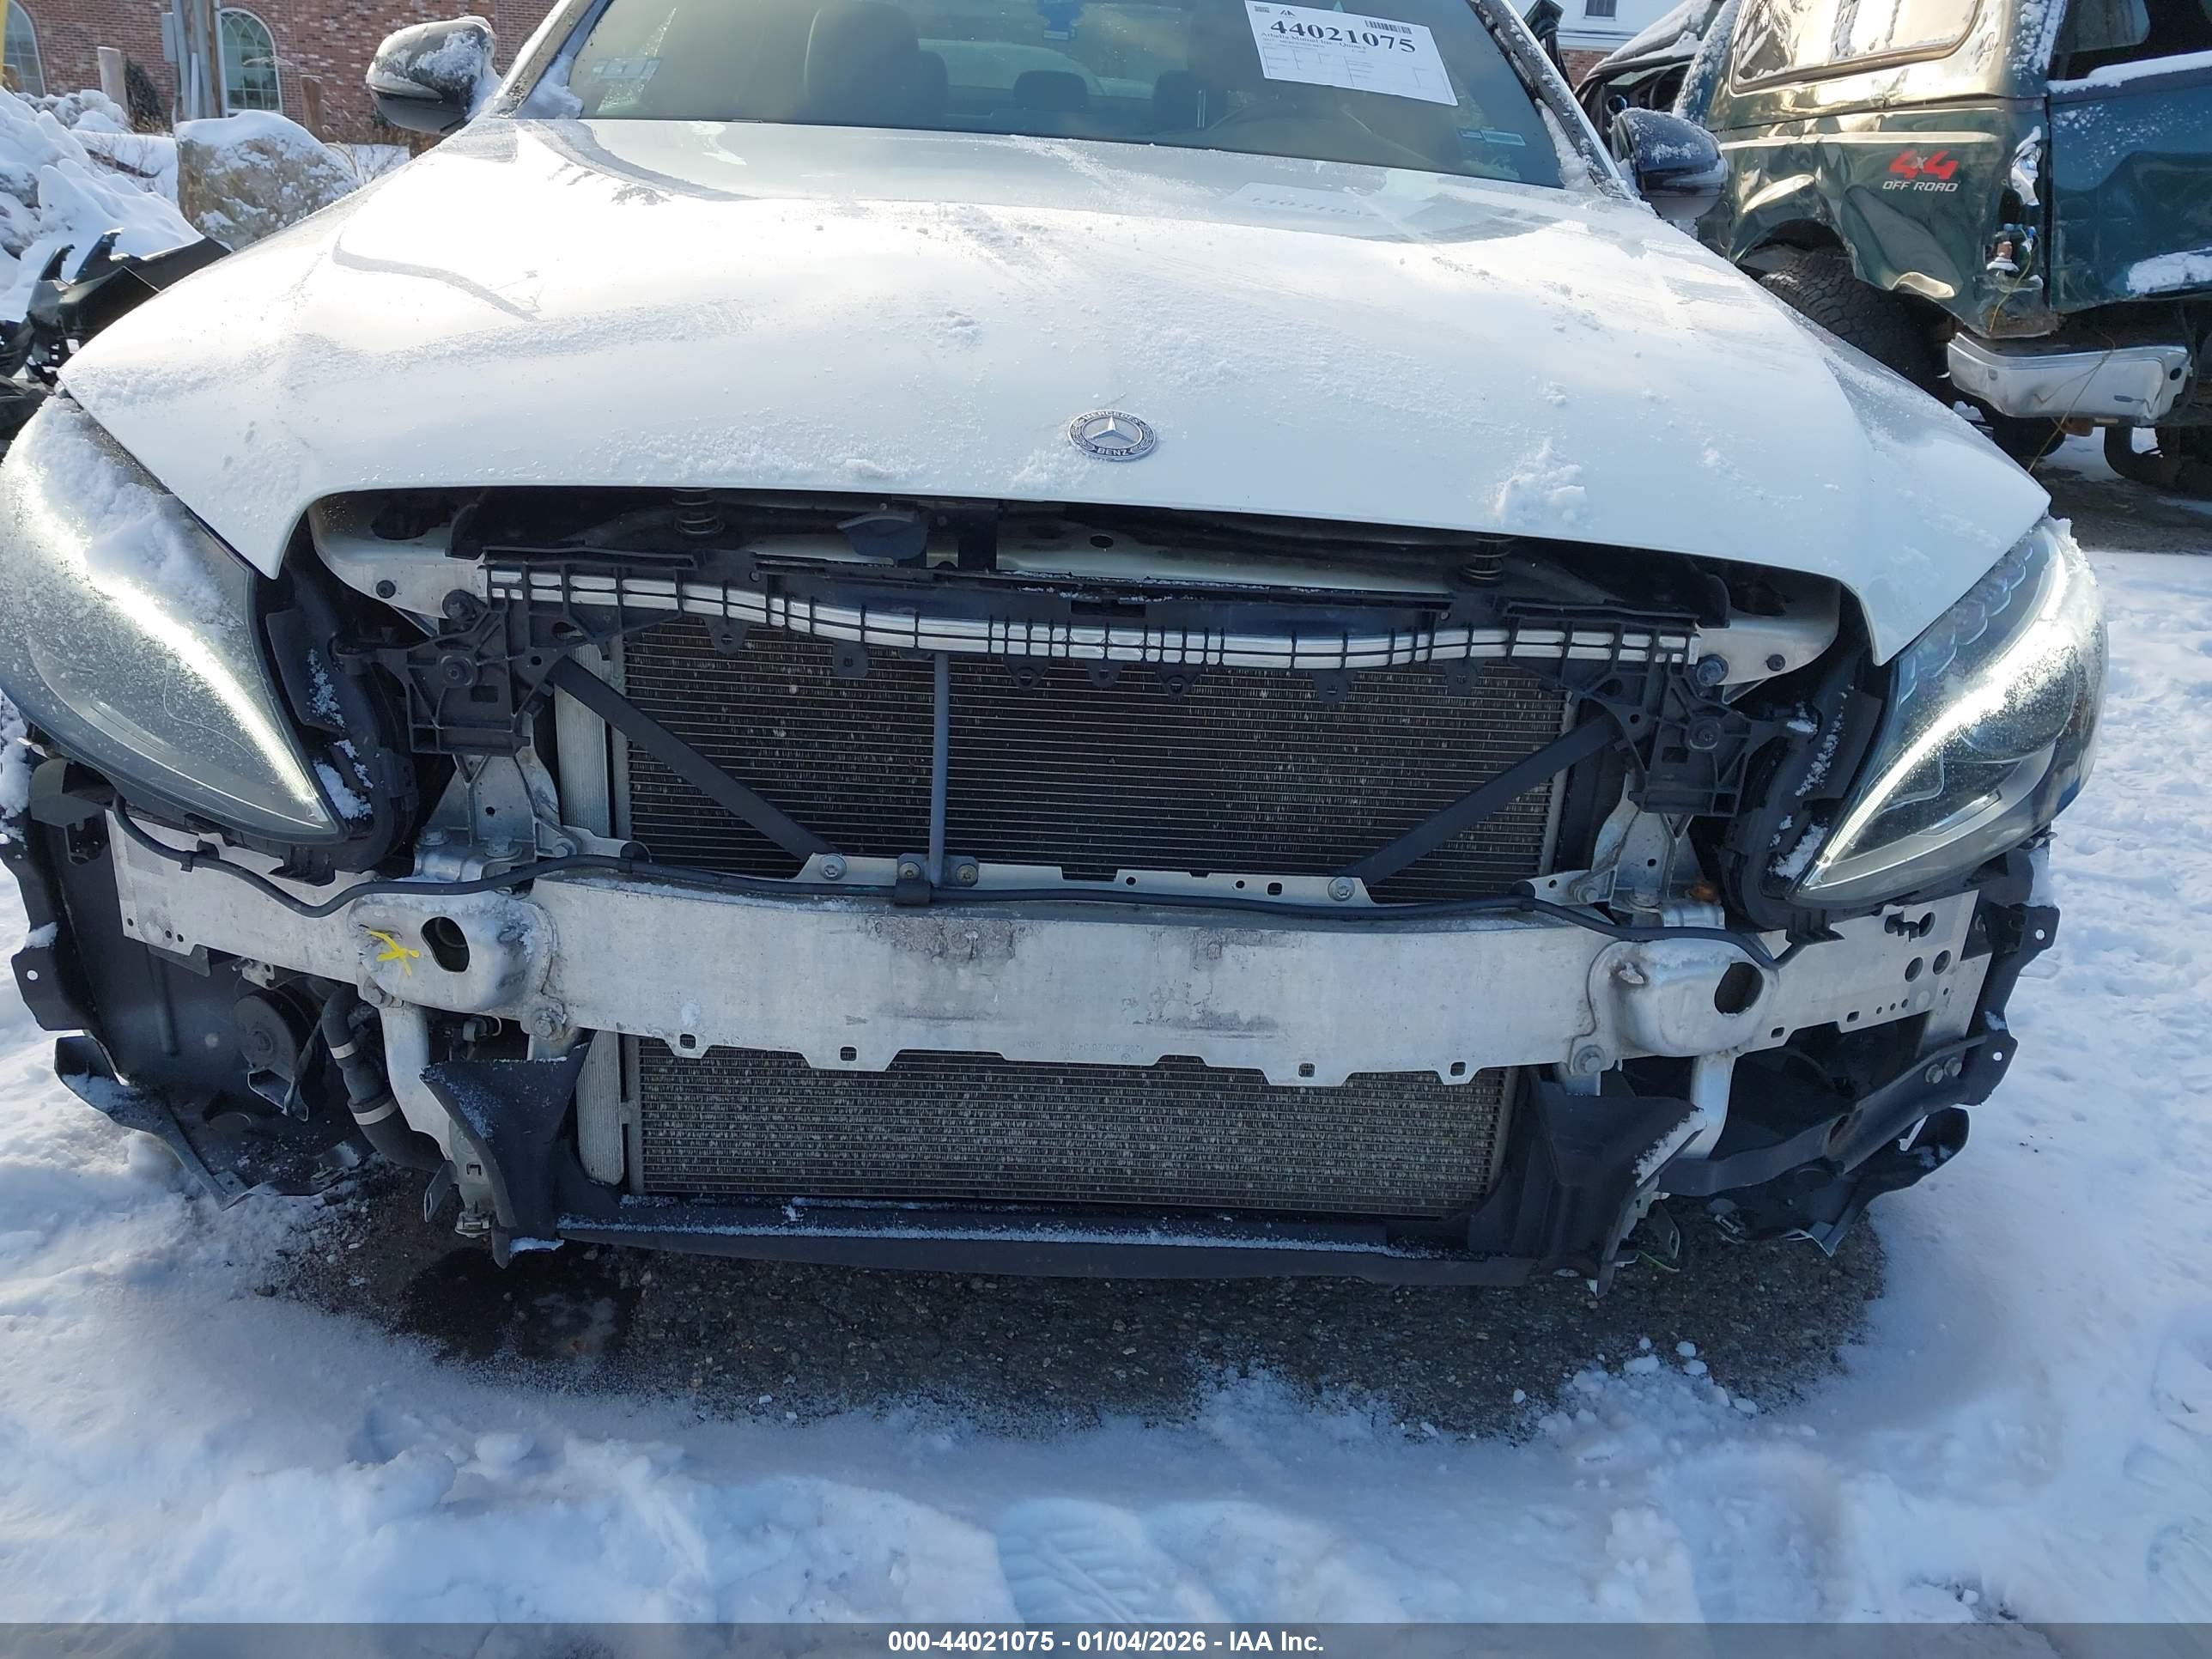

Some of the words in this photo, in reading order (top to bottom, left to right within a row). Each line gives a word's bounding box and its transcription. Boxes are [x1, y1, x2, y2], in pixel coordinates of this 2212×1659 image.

[1270, 20, 1416, 53] 44021075
[1882, 180, 1911, 191] OFF
[1913, 180, 1959, 192] ROAD
[1096, 447, 1129, 456] BENZ
